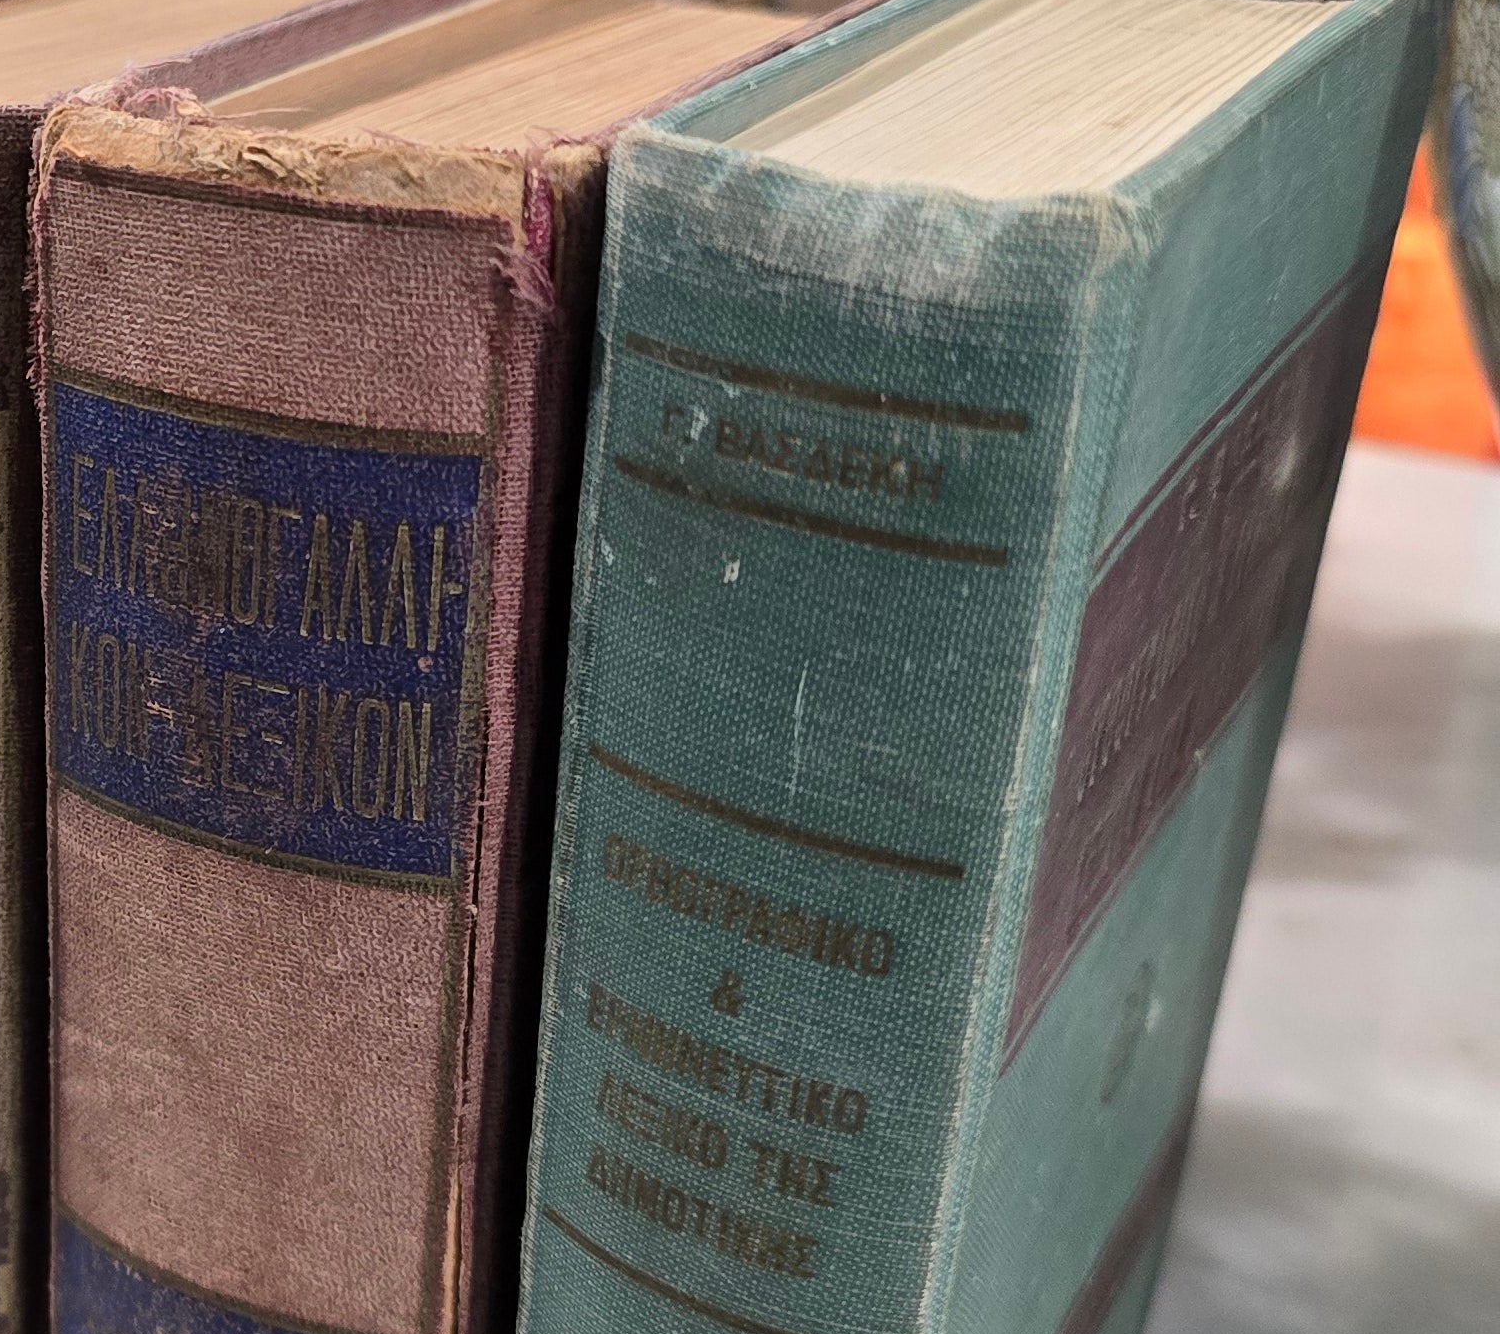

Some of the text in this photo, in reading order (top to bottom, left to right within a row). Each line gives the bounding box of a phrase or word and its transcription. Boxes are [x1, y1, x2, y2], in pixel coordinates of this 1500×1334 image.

[603, 831, 895, 979] ΟΡΘΟΓΡΑΦΙΚΟ
[708, 969, 746, 1019] &
[749, 1140, 843, 1210] ΤΗΣ
